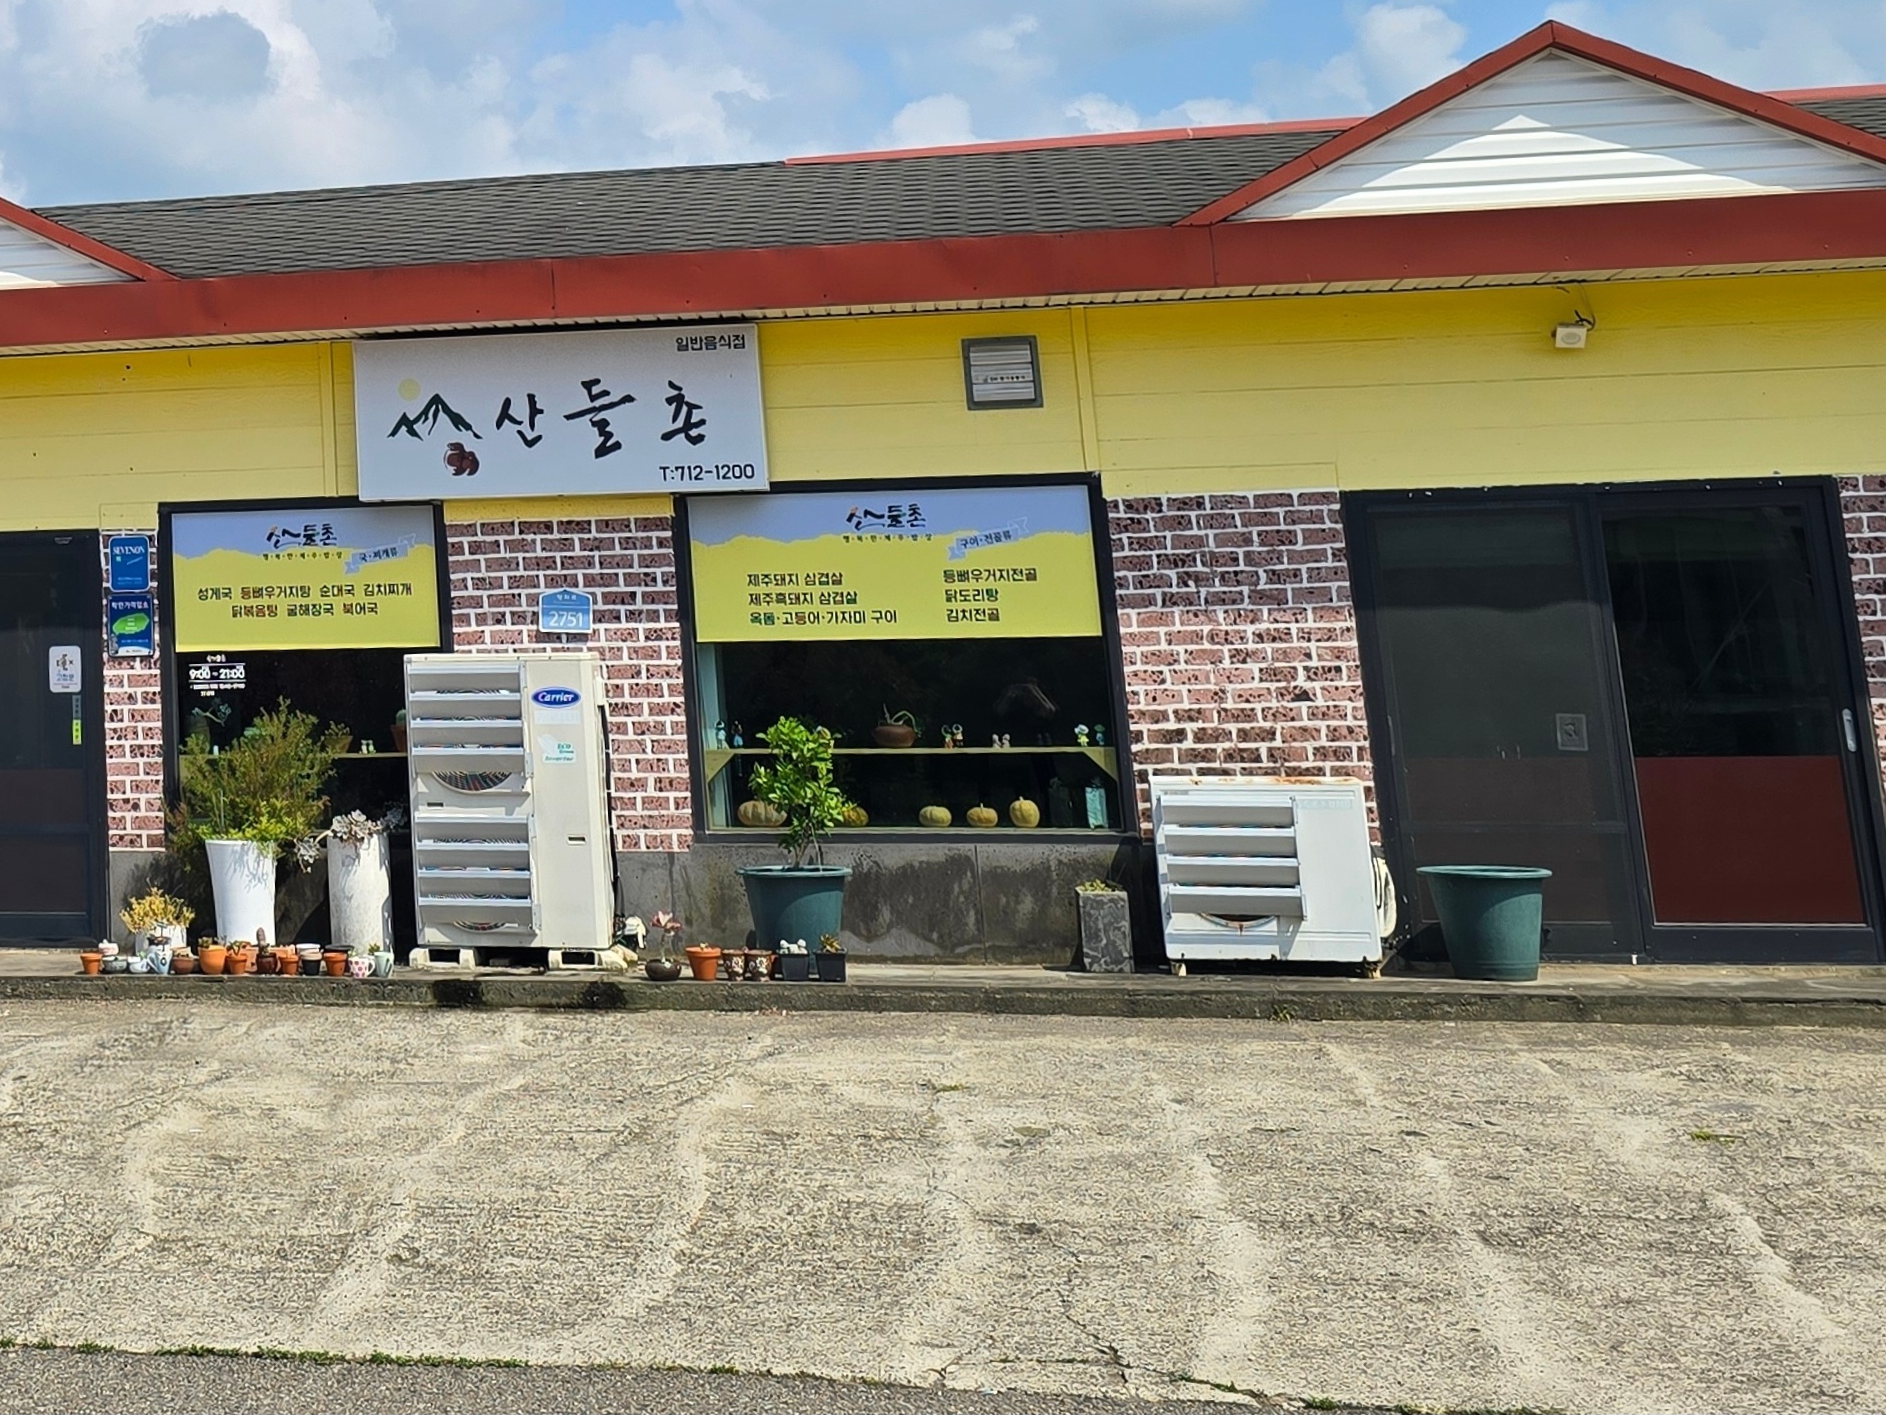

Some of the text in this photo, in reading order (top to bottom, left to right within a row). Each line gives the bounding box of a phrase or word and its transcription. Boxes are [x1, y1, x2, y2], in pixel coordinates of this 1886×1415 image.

[674, 334, 746, 352] 일반음식점
[494, 377, 708, 459] 산들촌
[659, 464, 756, 482] T:712-1200
[845, 503, 927, 531] 산들촌
[266, 523, 338, 549] 산들촌
[747, 572, 843, 587] 제주돼지 삼겹살
[943, 568, 1038, 584] 등뼈우거지전골
[197, 582, 412, 601] 성게국 등뼈우거지탕 순대국 김치찌개
[748, 591, 858, 607] 제주흑돼지 삼겹살
[944, 588, 999, 603] 닭도리탕
[286, 602, 334, 617] 굴해장국
[342, 602, 378, 616] 북어국
[749, 609, 898, 626] 옥돔·고등어·가자미 구이
[946, 607, 1000, 622] 김치전골
[549, 610, 583, 627] 2751
[538, 692, 574, 702] Carrier
